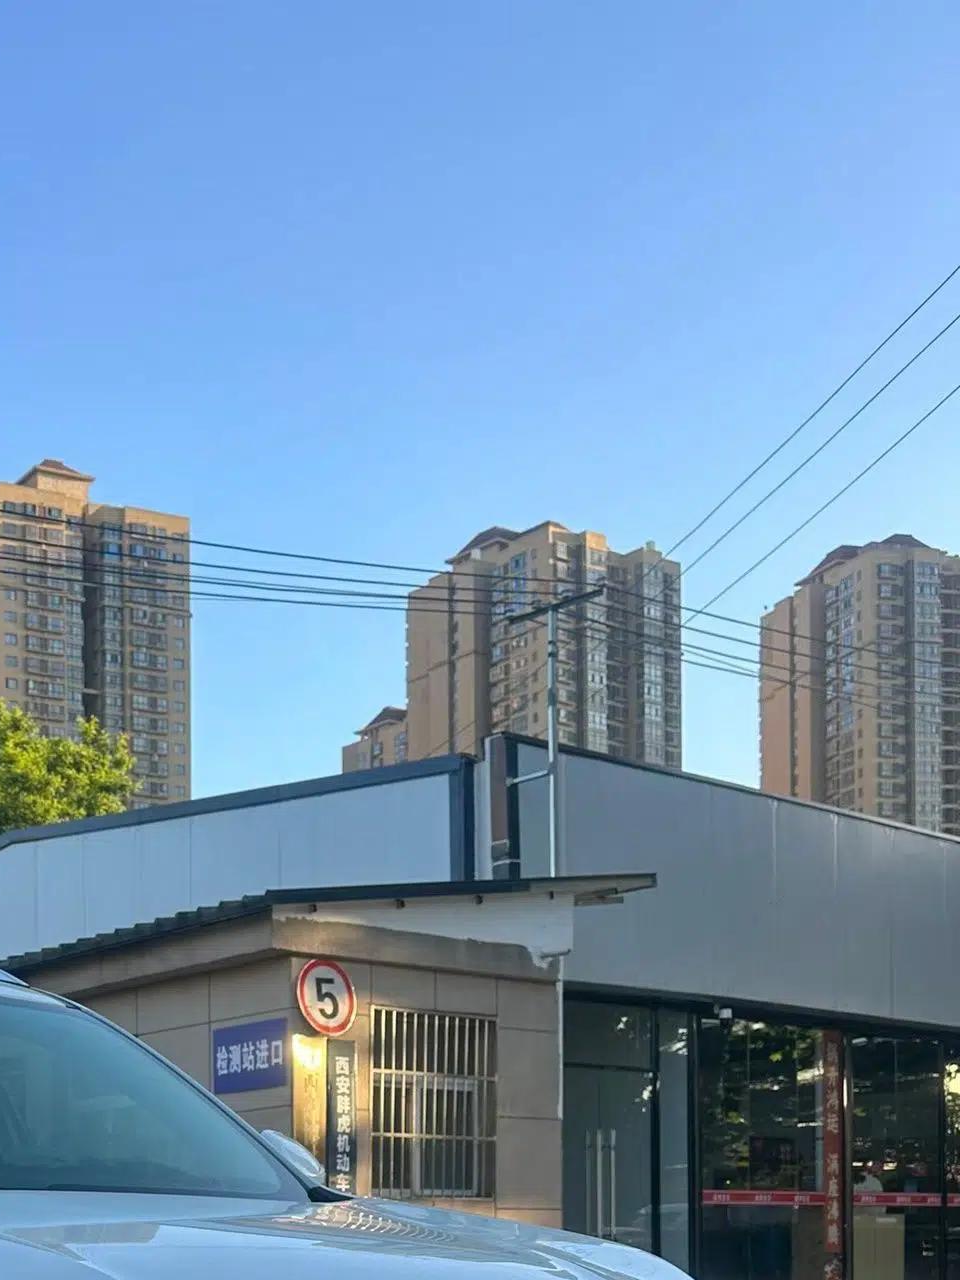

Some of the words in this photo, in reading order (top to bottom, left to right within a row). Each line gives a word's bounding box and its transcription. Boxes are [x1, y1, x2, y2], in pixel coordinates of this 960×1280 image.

[315, 977, 339, 1019] 5
[216, 1039, 283, 1076] 检测站进口
